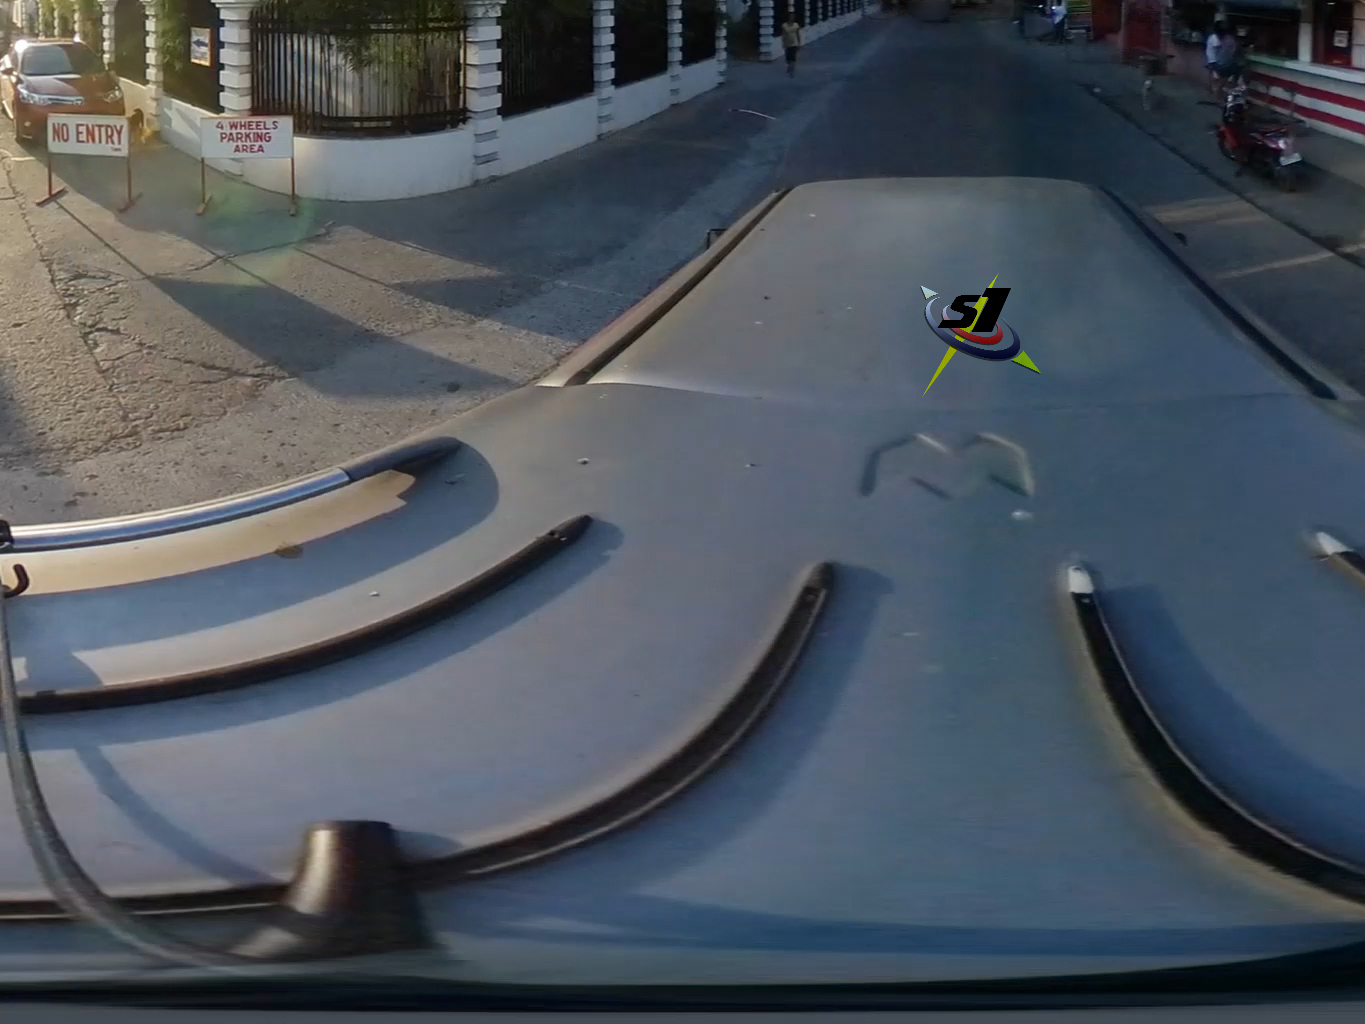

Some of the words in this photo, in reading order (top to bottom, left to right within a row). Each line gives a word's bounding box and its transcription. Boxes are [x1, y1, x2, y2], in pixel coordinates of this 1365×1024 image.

[215, 120, 225, 130] 4
[228, 120, 279, 131] WHEELS
[52, 122, 70, 144] NO
[76, 123, 125, 147] ENTRY
[219, 131, 273, 144] PARKING
[233, 144, 266, 154] AREA
